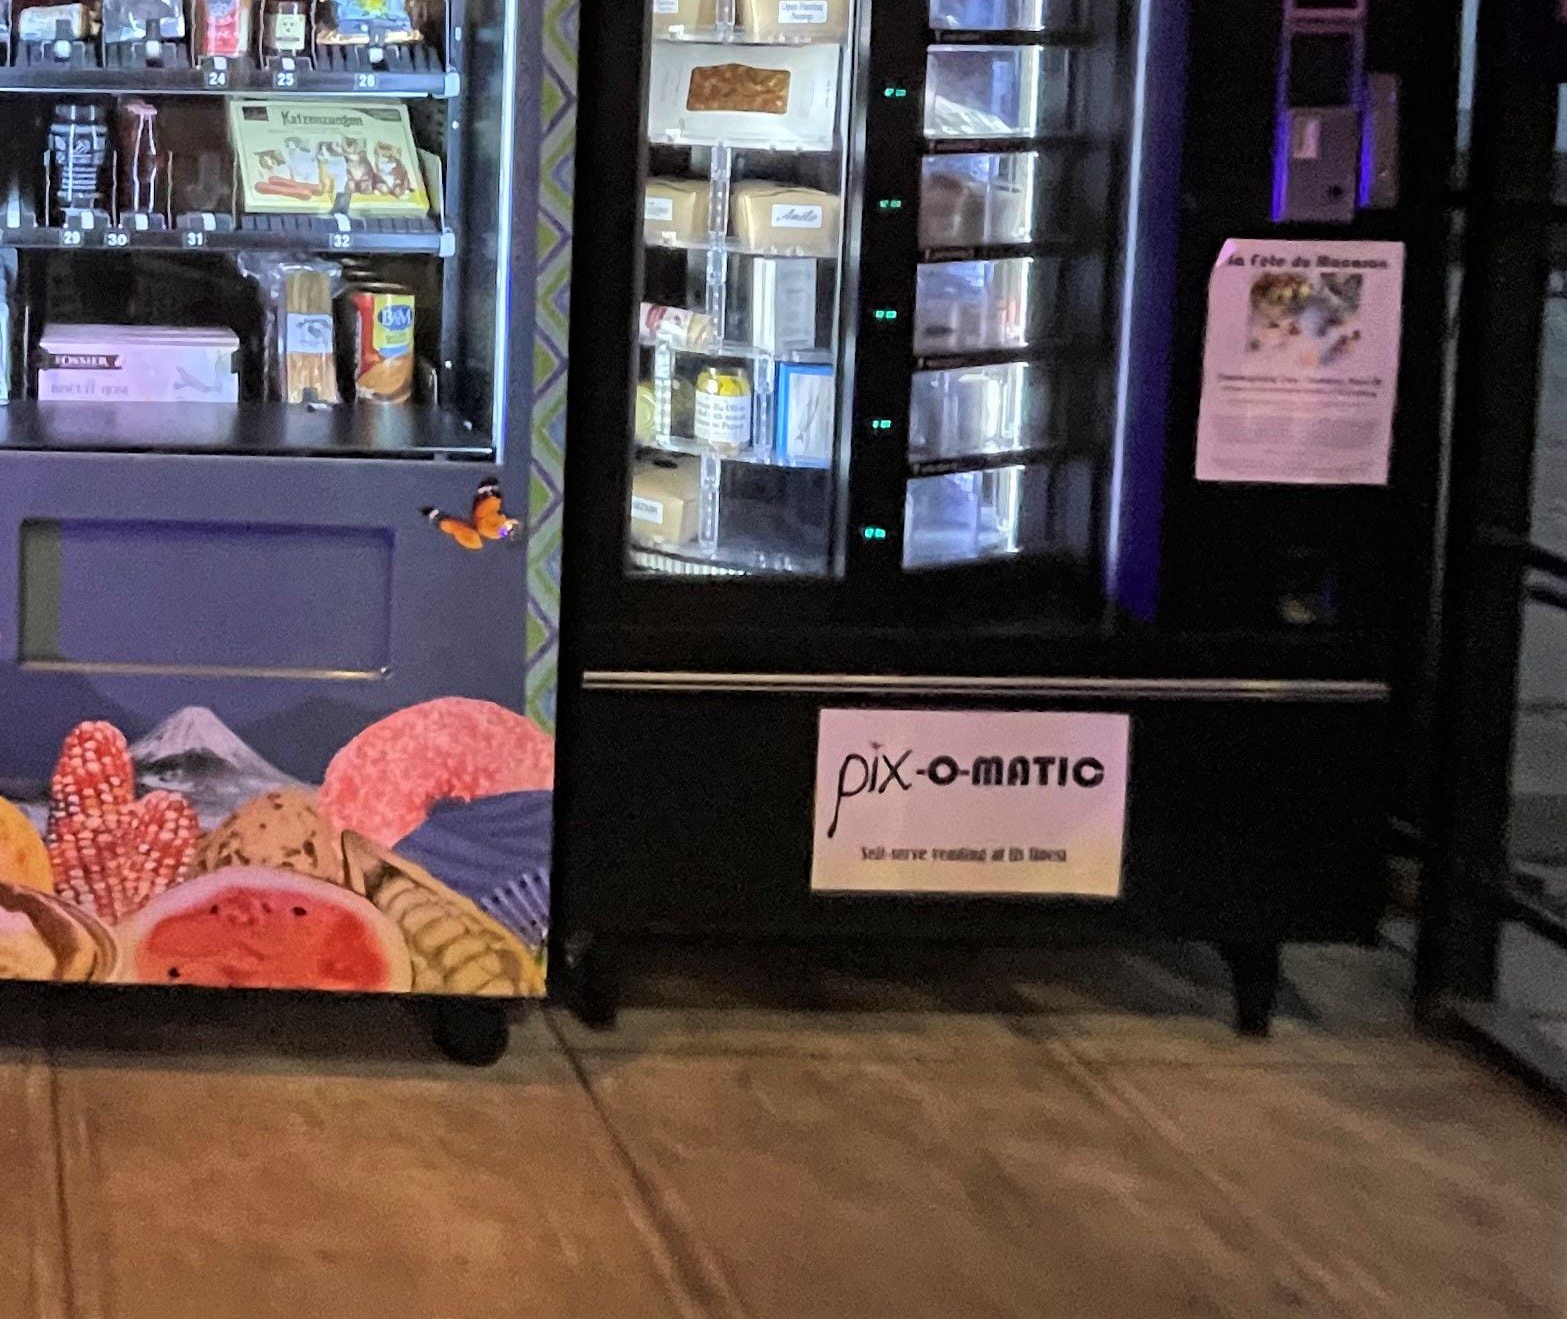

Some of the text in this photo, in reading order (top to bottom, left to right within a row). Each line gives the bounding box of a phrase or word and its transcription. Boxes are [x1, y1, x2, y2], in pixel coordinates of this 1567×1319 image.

[208, 72, 226, 85] 24
[277, 72, 294, 85] 25
[64, 231, 81, 244] 29
[107, 233, 127, 246] 30
[187, 232, 203, 245] 31
[333, 234, 350, 247] 32
